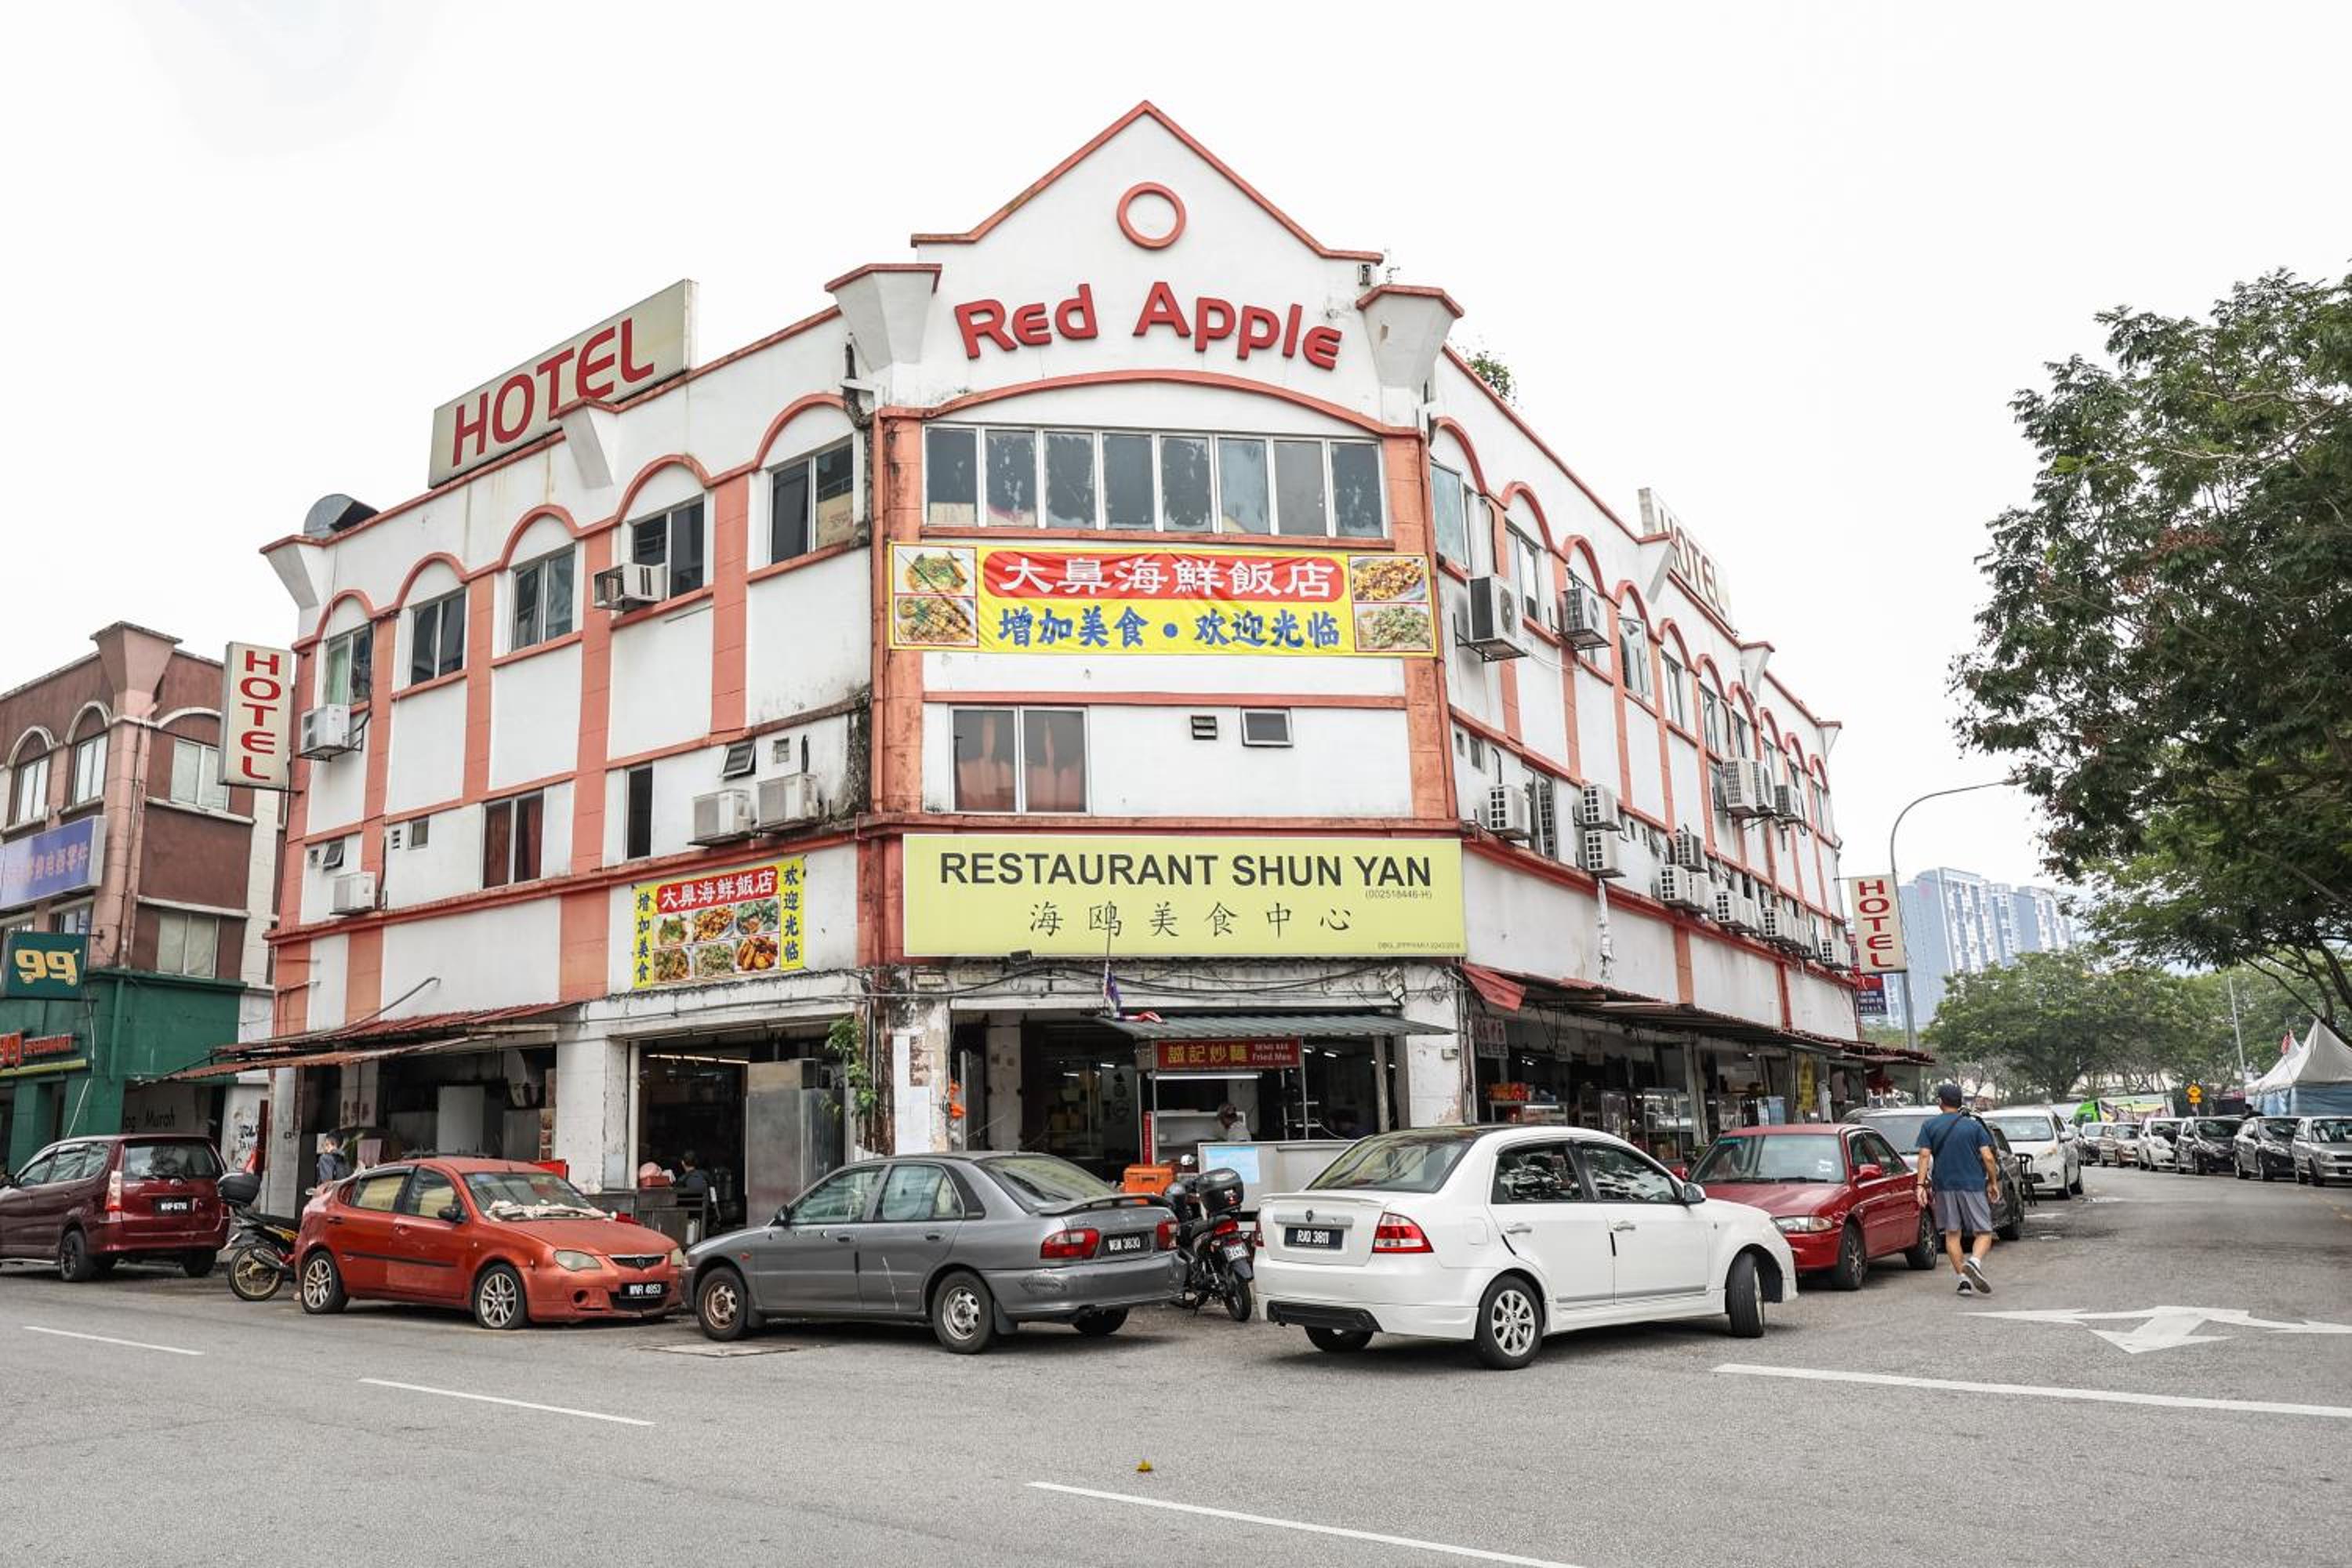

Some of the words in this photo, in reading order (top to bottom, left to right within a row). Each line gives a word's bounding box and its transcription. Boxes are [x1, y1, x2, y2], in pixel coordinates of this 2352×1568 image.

[954, 283, 1098, 359] Red
[1133, 281, 1343, 371] Apple
[452, 318, 655, 466] HOTEL
[998, 554, 1335, 599] 大鼻海鮮飯店
[1659, 507, 1726, 618] HOTEL
[997, 605, 1149, 648] 增加美食
[1194, 607, 1341, 649] 欢迎光临
[239, 650, 280, 781] HOTEL
[661, 869, 776, 910] 大鼻海鮮飯店
[940, 851, 1218, 886] RESTAURANT
[1232, 855, 1343, 887] SHUN
[1353, 856, 1431, 887] YAN
[784, 866, 799, 963] 欢迎光临
[1029, 900, 1352, 938] 海鸥美食中心
[1857, 879, 1895, 968] HOTEL
[15, 949, 78, 986] 99
